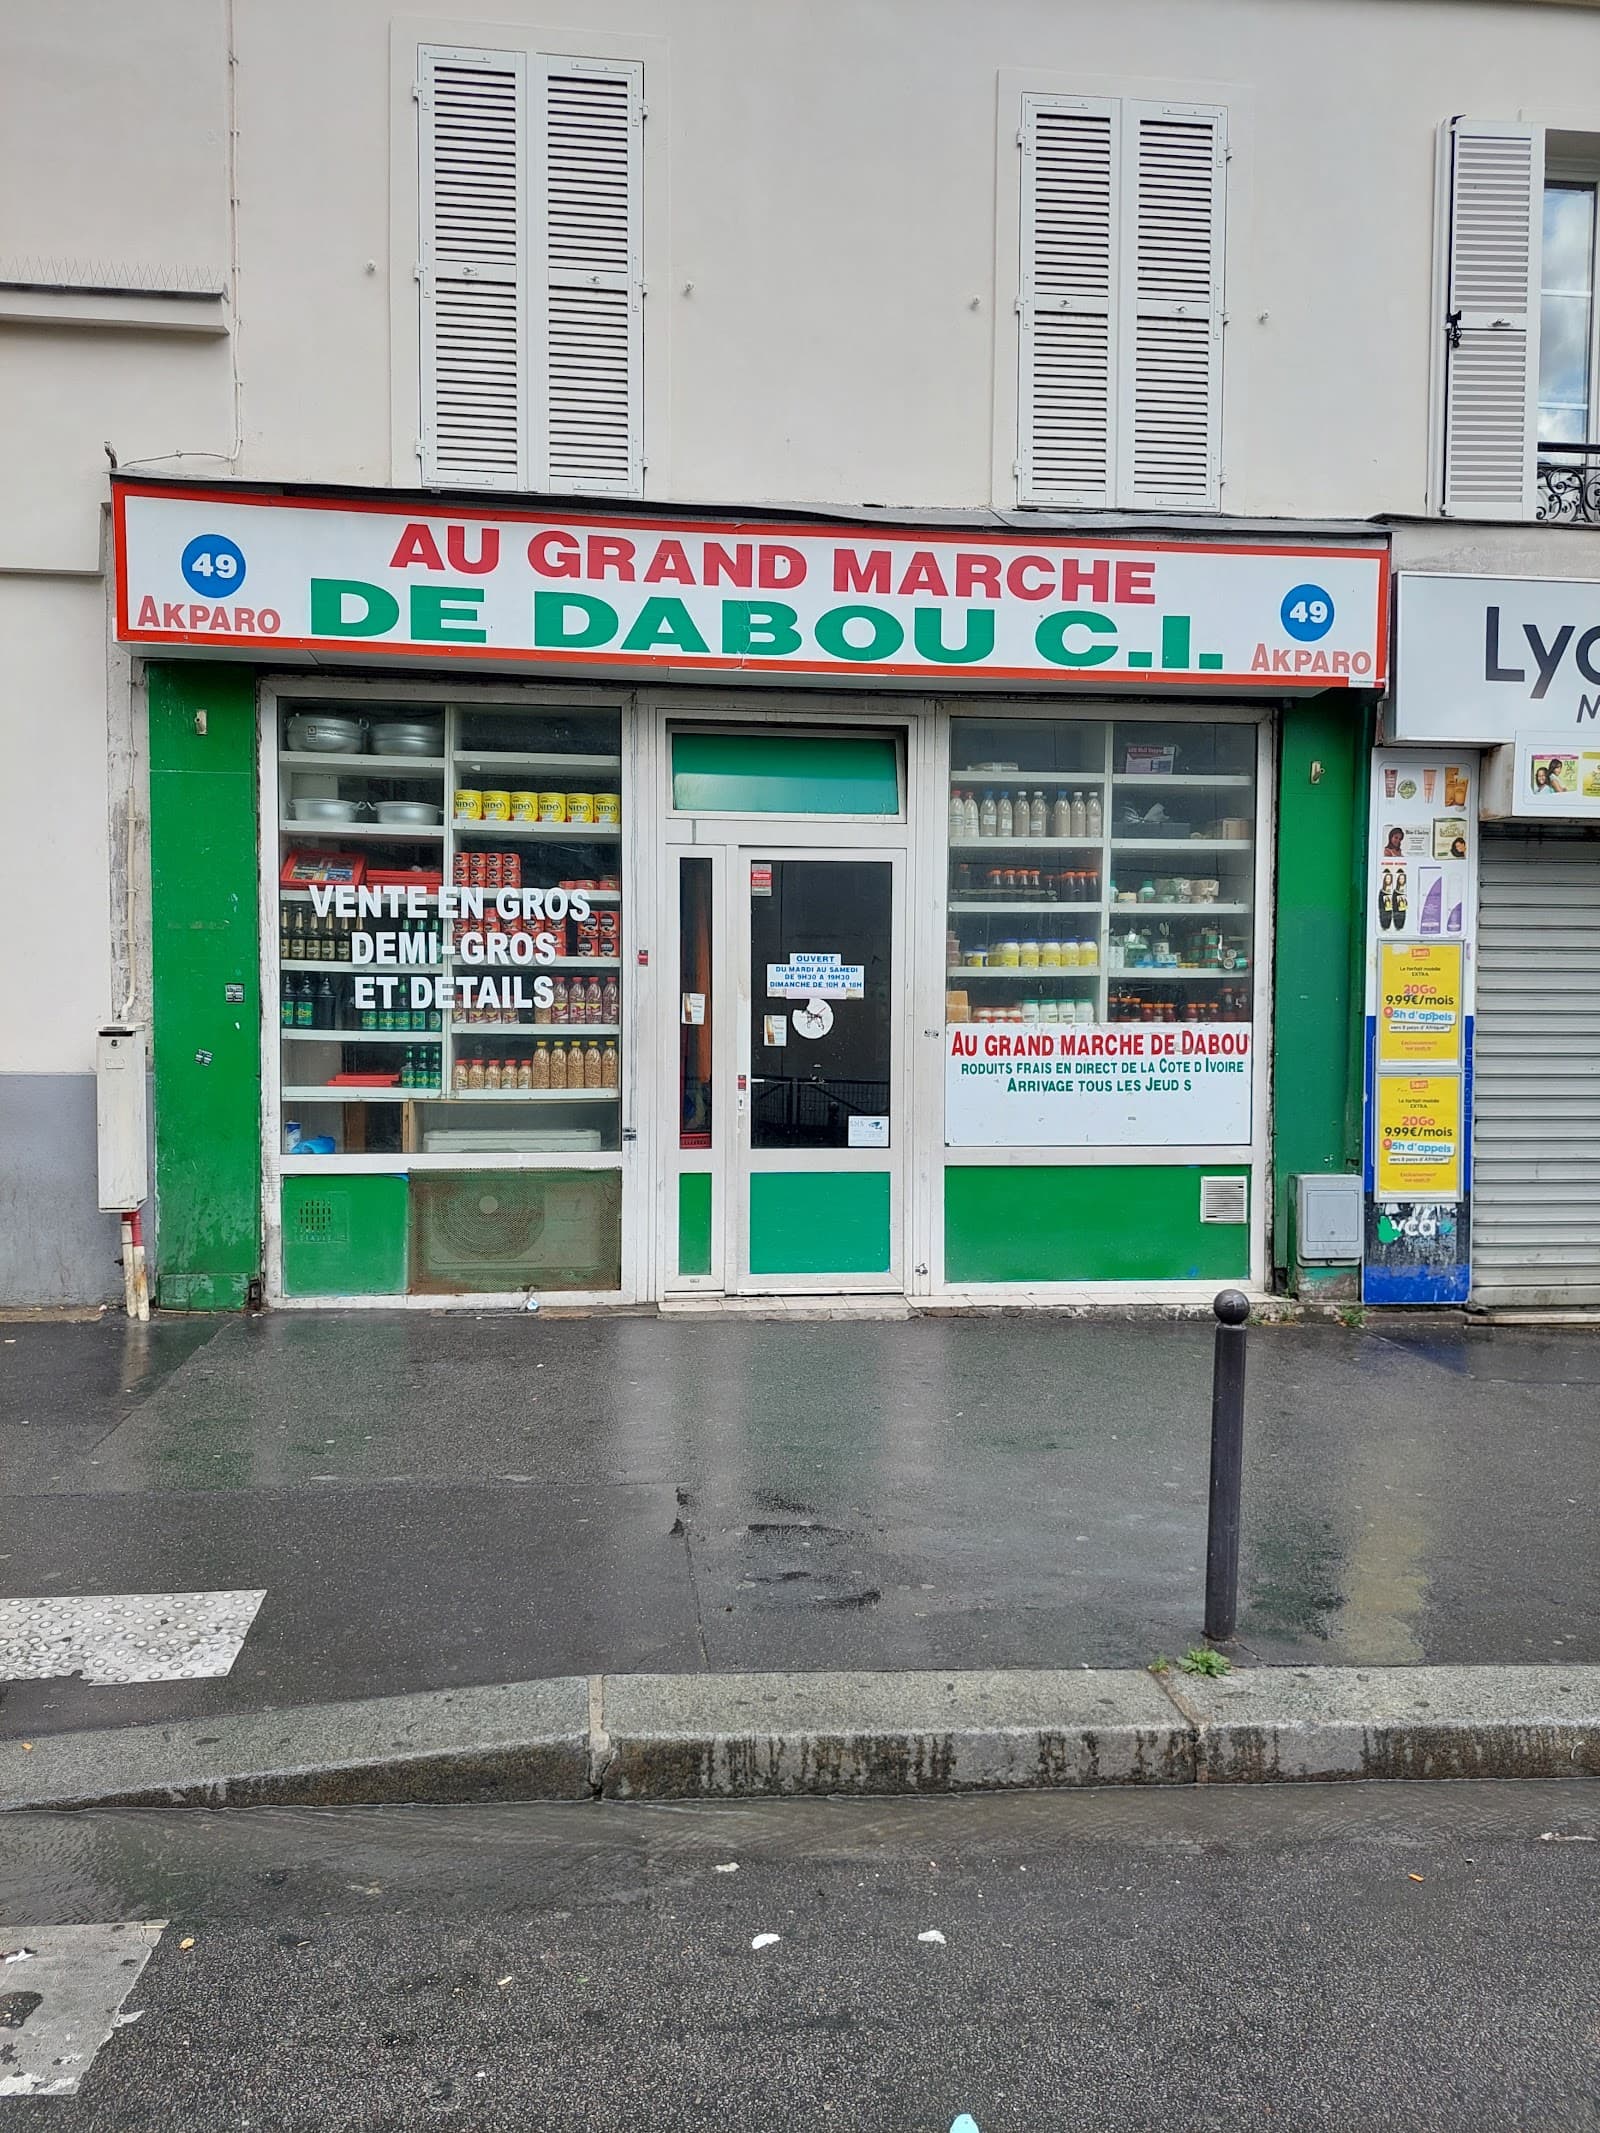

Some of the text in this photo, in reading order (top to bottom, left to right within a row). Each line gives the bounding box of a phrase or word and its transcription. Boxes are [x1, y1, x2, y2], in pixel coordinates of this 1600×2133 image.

[192, 553, 237, 579] 49
[390, 522, 1156, 604] AU GRAND MARCHE
[137, 595, 281, 635] AKPARO
[310, 578, 1224, 670] DE DABOU C.I.
[1289, 601, 1328, 624] 49
[1252, 643, 1372, 676] AKPARO
[309, 885, 591, 922] VENTE EN GROS
[351, 931, 556, 965] DEMI-GROS
[354, 975, 554, 1009] ET DETAILS
[1385, 995, 1454, 1005] 9.99€/mois
[1403, 984, 1437, 995] 20Go
[951, 1030, 1249, 1057] AU GRAND MARCHE DE DABOU
[961, 1062, 1013, 1075] RODUITS
[1016, 1062, 1052, 1074] FRAIS
[1056, 1062, 1072, 1074] EN
[1075, 1062, 1118, 1074] DIRECT
[1121, 1062, 1137, 1074] DE
[1140, 1061, 1155, 1073] LA
[1159, 1058, 1191, 1073] COTE
[1205, 1057, 1244, 1073] IVOIRE
[1007, 1077, 1073, 1092] ARRIVAGE
[1078, 1080, 1113, 1092] TOUS
[1117, 1080, 1142, 1092] LES
[1384, 1127, 1453, 1137] 9.99€/mois
[1402, 1116, 1435, 1126] 20Go
